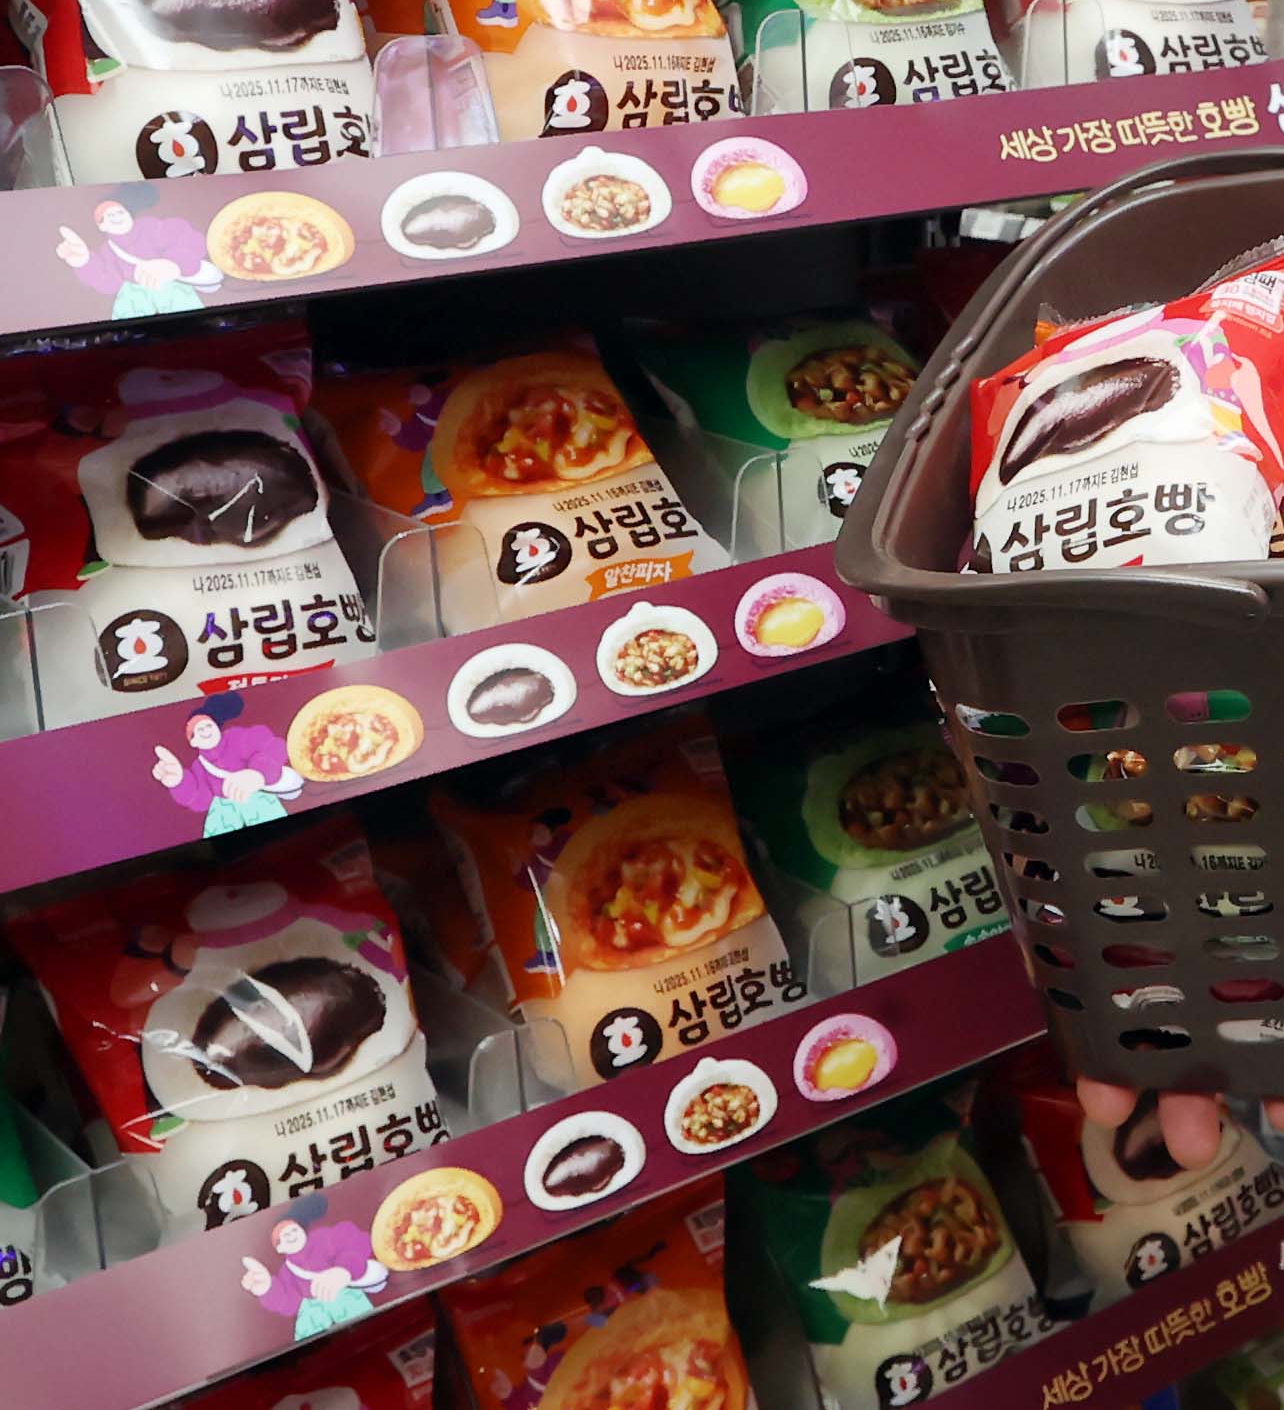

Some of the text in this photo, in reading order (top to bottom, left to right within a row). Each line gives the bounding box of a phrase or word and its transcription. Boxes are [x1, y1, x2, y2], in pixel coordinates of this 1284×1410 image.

[227, 105, 374, 173] 삼립호
[1000, 124, 1058, 163] 세상
[1060, 118, 1118, 156] 가장
[1117, 109, 1198, 147] 따뜻한
[1196, 95, 1261, 141] 호빵
[1006, 471, 1110, 512] 나2025.11.17까지E
[999, 481, 1217, 574] 삼립호빵
[603, 560, 673, 590] 알찬피자
[1041, 1362, 1093, 1410] 세상
[1093, 1334, 1144, 1383] 가장
[1214, 1261, 1274, 1321] 호빵
